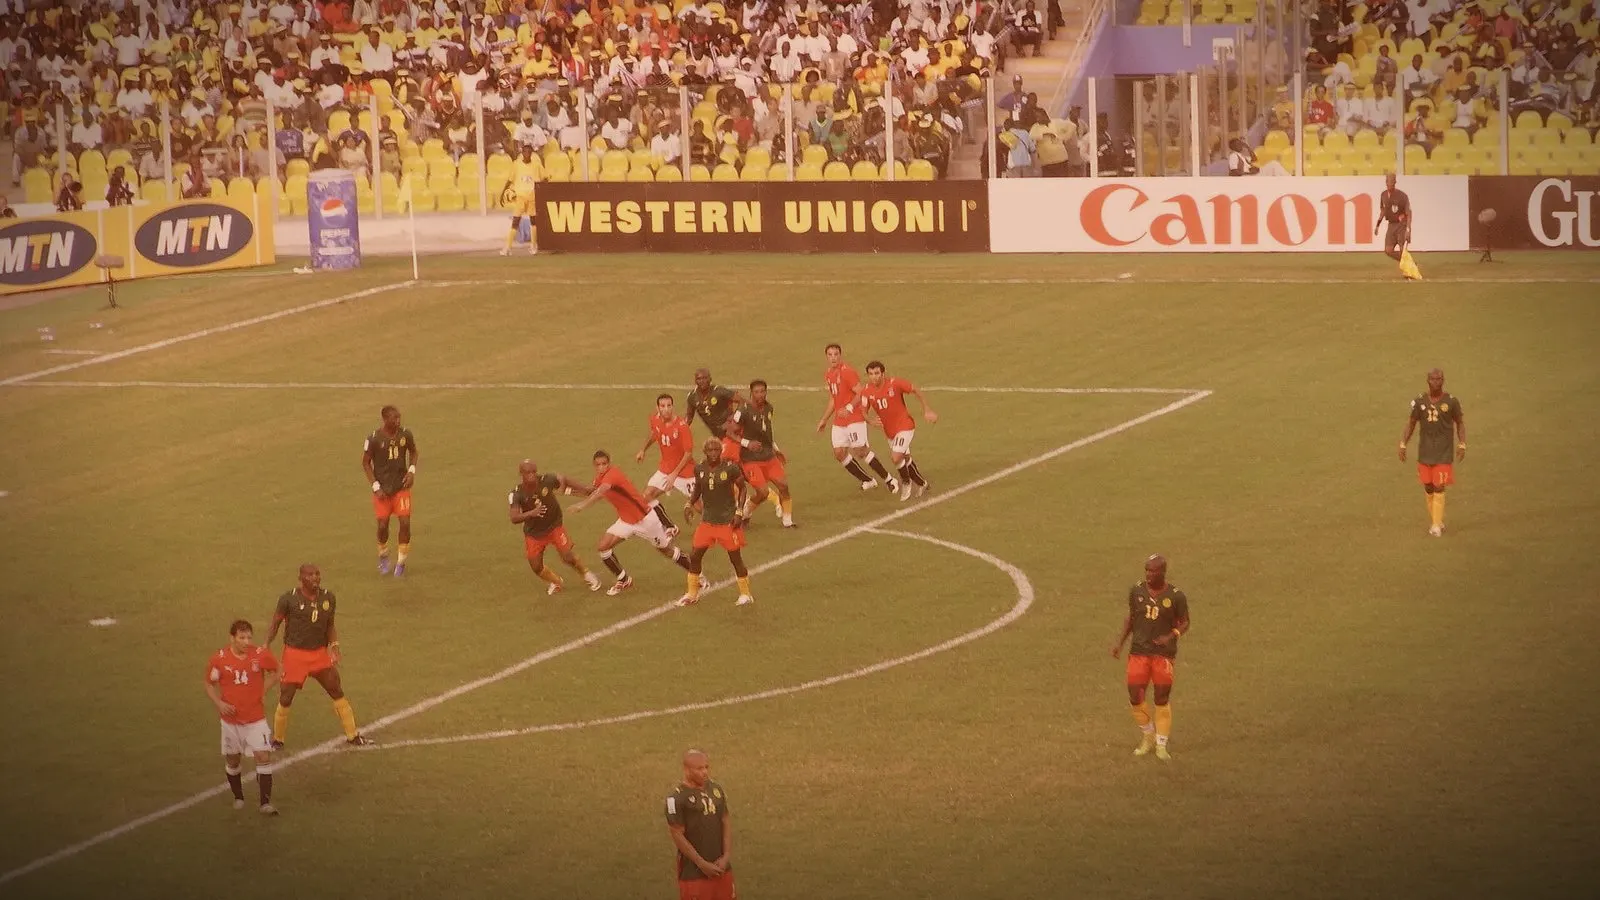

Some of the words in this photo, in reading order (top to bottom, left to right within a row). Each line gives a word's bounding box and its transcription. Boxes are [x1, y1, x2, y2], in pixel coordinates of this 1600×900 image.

[156, 213, 232, 256] MTN
[546, 200, 762, 233] WESTERN
[784, 200, 934, 234] UNION
[1079, 183, 1374, 246] Canon
[0, 230, 75, 275] MTN
[877, 398, 888, 410] 10
